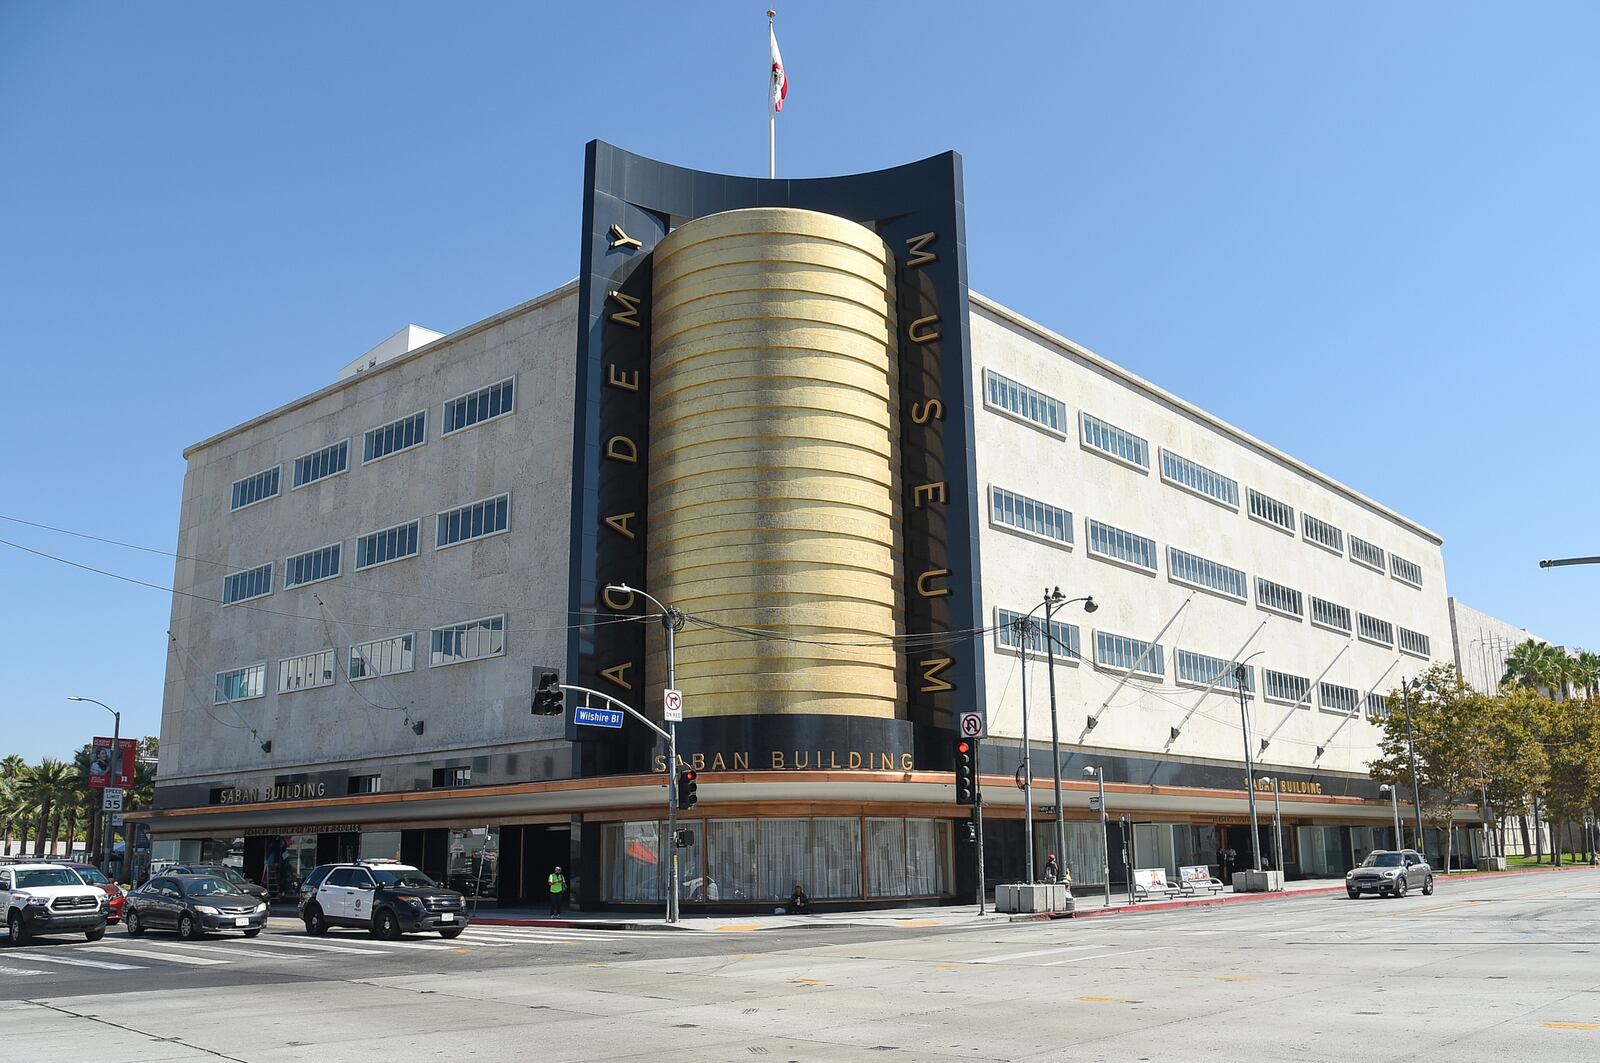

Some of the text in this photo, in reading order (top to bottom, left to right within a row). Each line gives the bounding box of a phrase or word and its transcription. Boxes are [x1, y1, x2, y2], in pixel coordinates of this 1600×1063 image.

[600, 223, 643, 690] ACADEMY
[905, 231, 953, 693] MUSEUM
[579, 711, 609, 722] Wilshire
[772, 751, 914, 771] BUILDING
[220, 782, 325, 803] SABAN BUILDING
[1280, 780, 1322, 794] BUILDING
[104, 800, 121, 809] 35
